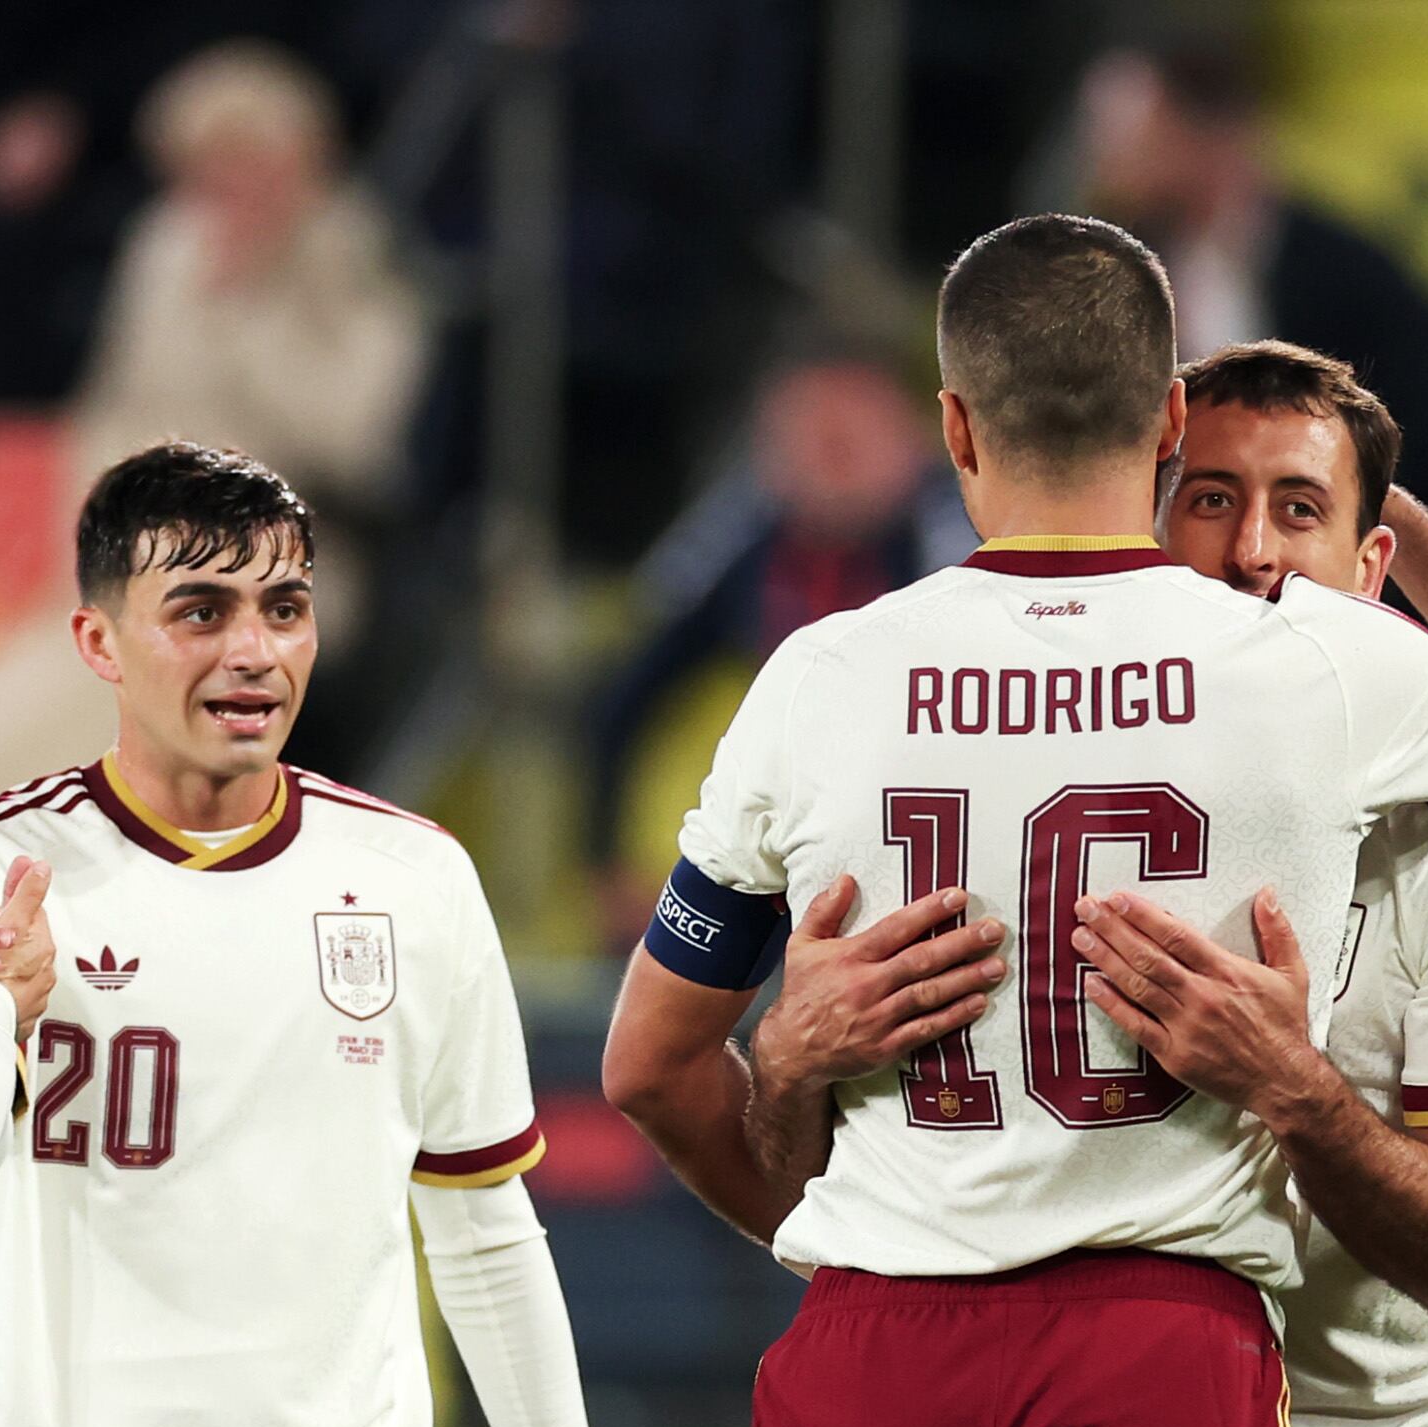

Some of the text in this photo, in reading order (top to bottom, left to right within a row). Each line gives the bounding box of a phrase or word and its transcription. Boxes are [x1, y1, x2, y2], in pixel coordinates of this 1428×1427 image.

[907, 657, 1195, 735] RODRIGO
[883, 782, 1209, 1130] 16
[32, 1018, 180, 1169] 20
